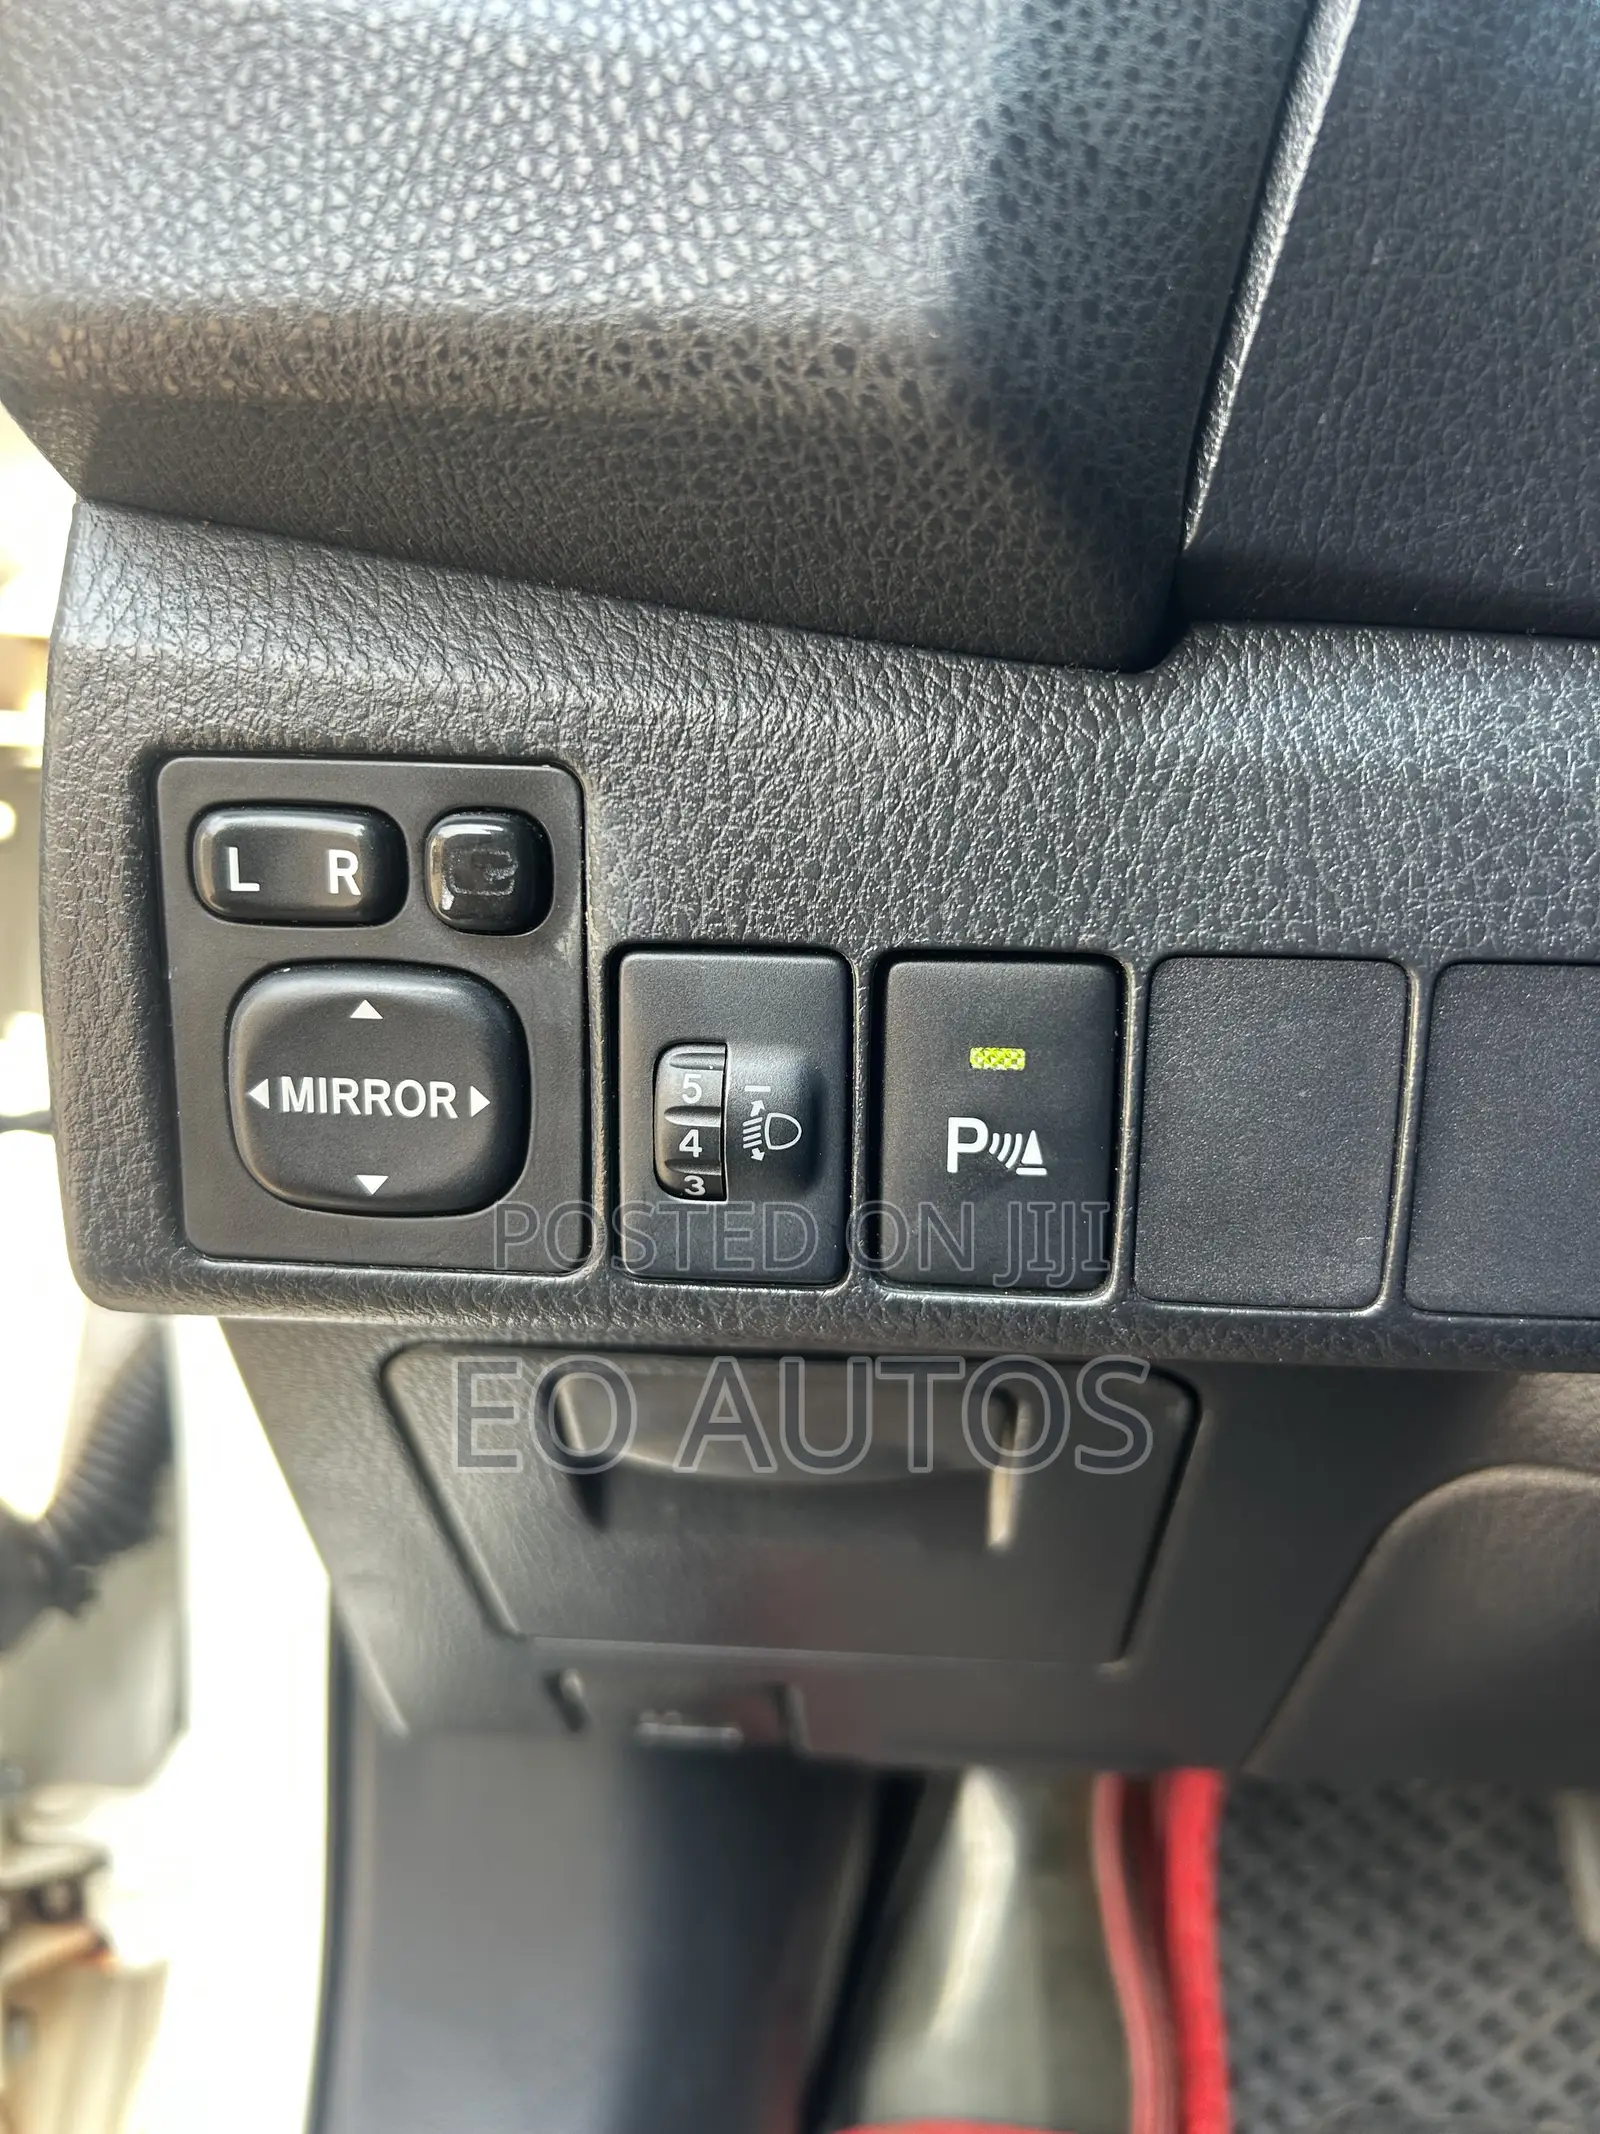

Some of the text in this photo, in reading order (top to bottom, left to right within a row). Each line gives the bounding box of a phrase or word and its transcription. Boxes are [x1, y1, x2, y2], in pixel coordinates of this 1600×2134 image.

[228, 847, 362, 896] L R
[280, 1076, 459, 1119] MIRROR
[682, 1073, 702, 1104] 5
[679, 1129, 702, 1158] 4
[947, 1117, 988, 1174] P
[684, 1175, 706, 1197] 3
